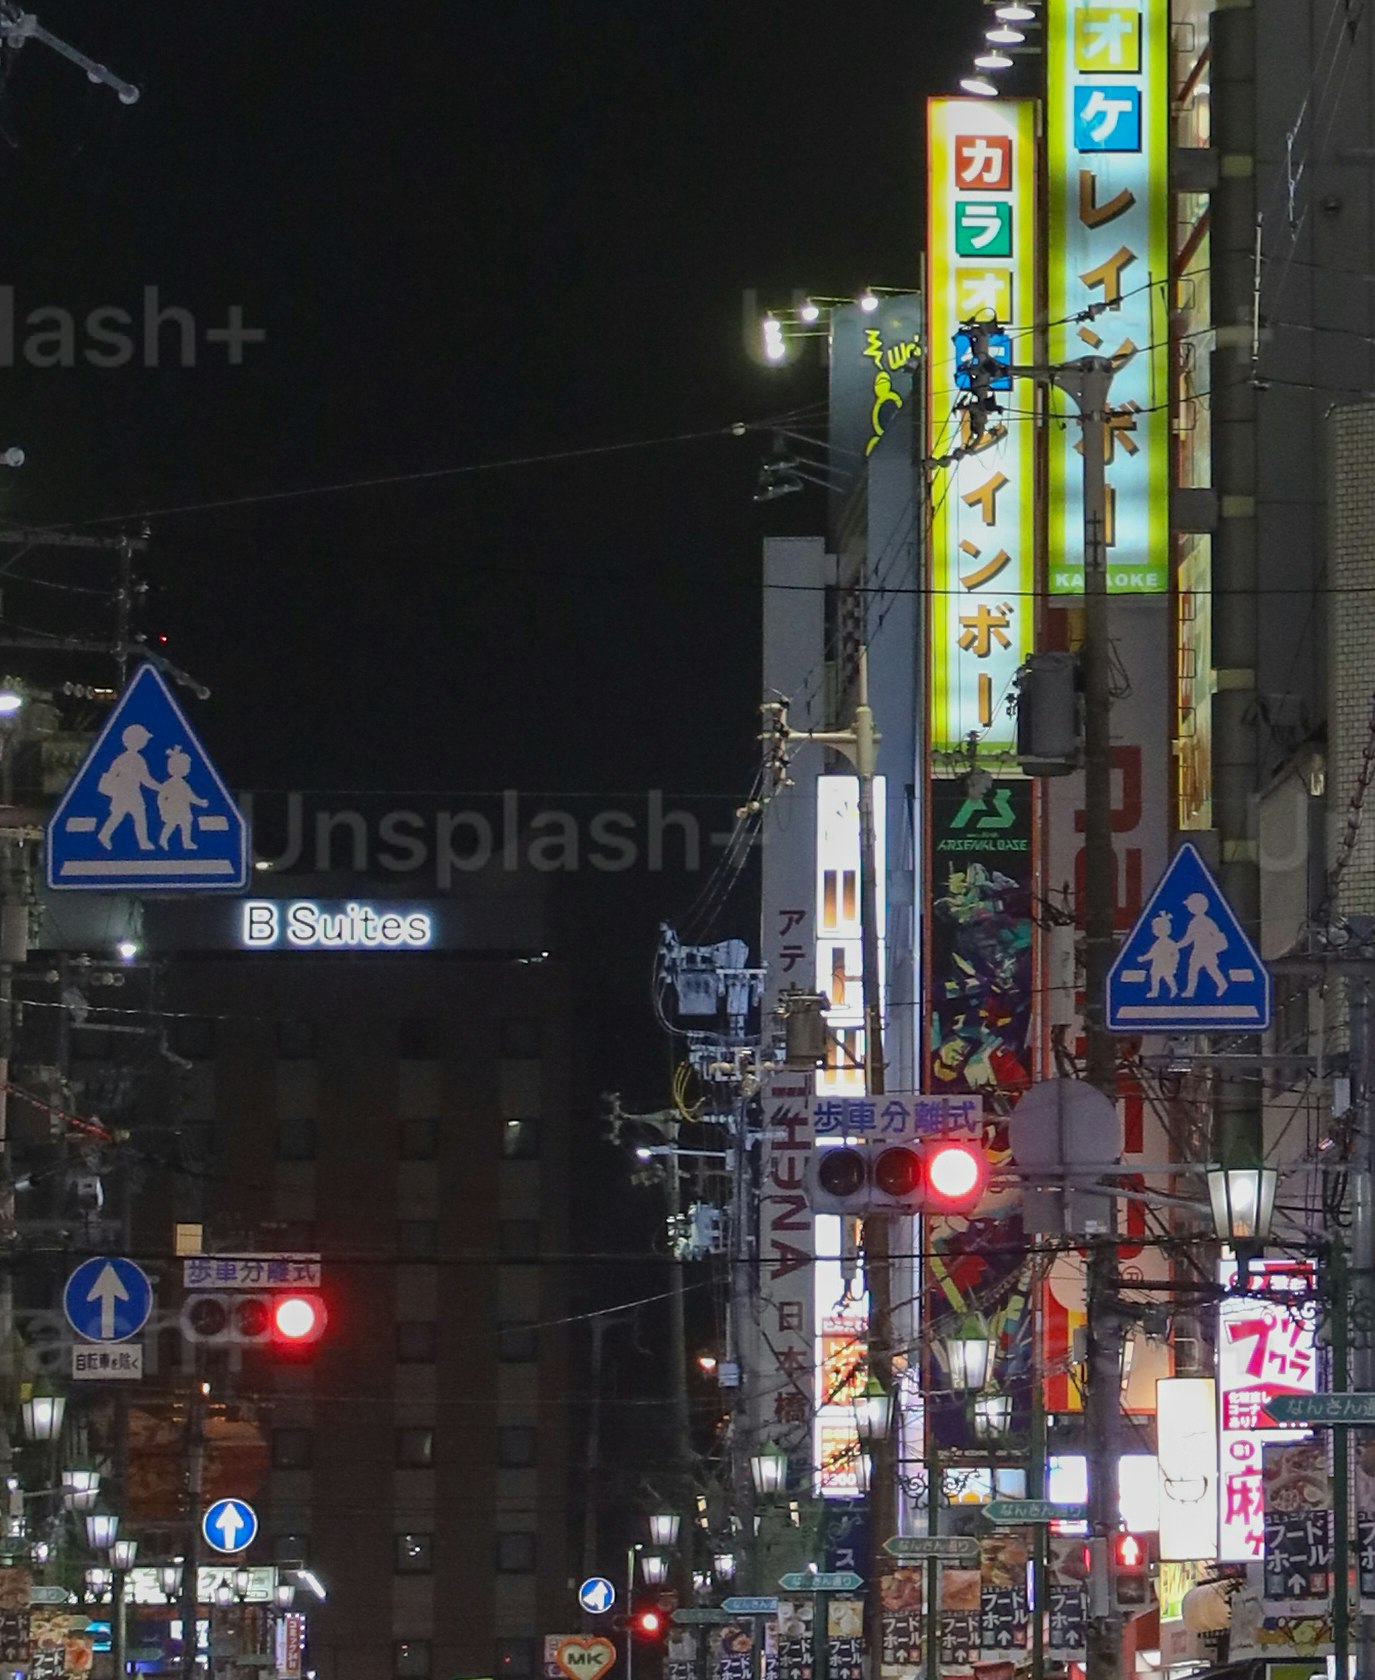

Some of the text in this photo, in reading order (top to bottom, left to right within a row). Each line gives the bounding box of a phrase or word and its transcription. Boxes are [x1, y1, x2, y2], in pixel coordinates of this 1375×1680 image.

[1076, 166, 1142, 549] レインボー
[1055, 572, 1158, 587] KAAOKE
[245, 898, 432, 949] B Suites
[812, 1098, 982, 1136] 歩車分離式
[187, 1258, 316, 1284] 歩車分離式
[1225, 1308, 1314, 1384] プリクラ
[75, 1353, 139, 1371] 自転車を除く
[1266, 1519, 1324, 1547] フード
[1266, 1545, 1330, 1574] ホール
[982, 1590, 1025, 1611] フード
[882, 1617, 920, 1633] フード
[942, 1617, 979, 1633] フード
[982, 1609, 1028, 1629] ホール
[882, 1632, 923, 1648] ホール
[941, 1632, 981, 1649] ホール
[567, 1652, 604, 1665] MK
